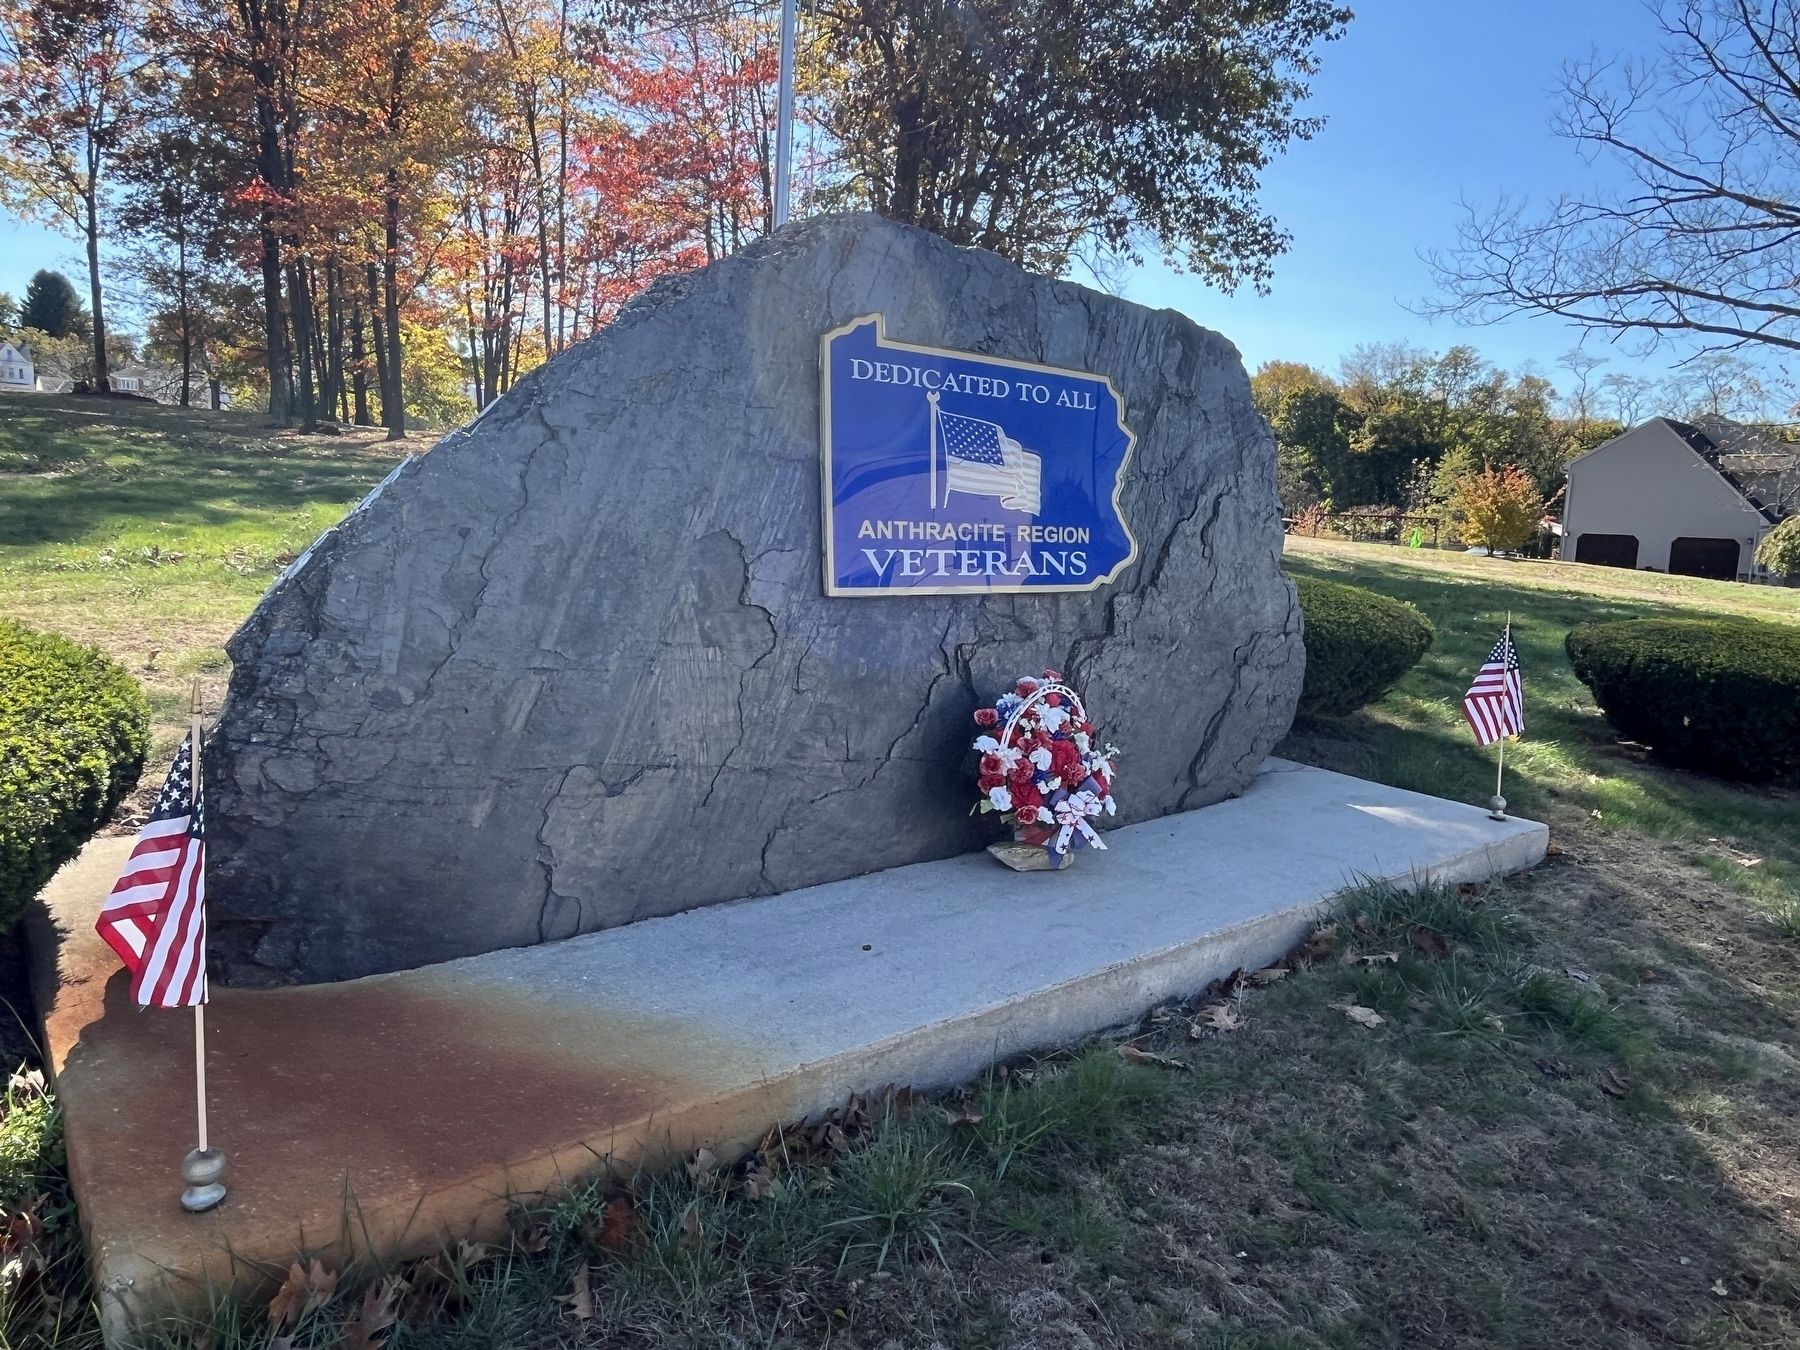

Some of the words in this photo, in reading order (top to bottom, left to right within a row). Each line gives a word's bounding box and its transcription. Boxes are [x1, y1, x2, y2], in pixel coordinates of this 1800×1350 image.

[850, 358, 1010, 398] DEDICATED
[1016, 382, 1050, 404] TO
[1056, 389, 1096, 410] ALL
[858, 519, 1005, 542] ANTHRACITE
[1017, 525, 1090, 544] REGION
[860, 548, 1088, 577] VETERANS
